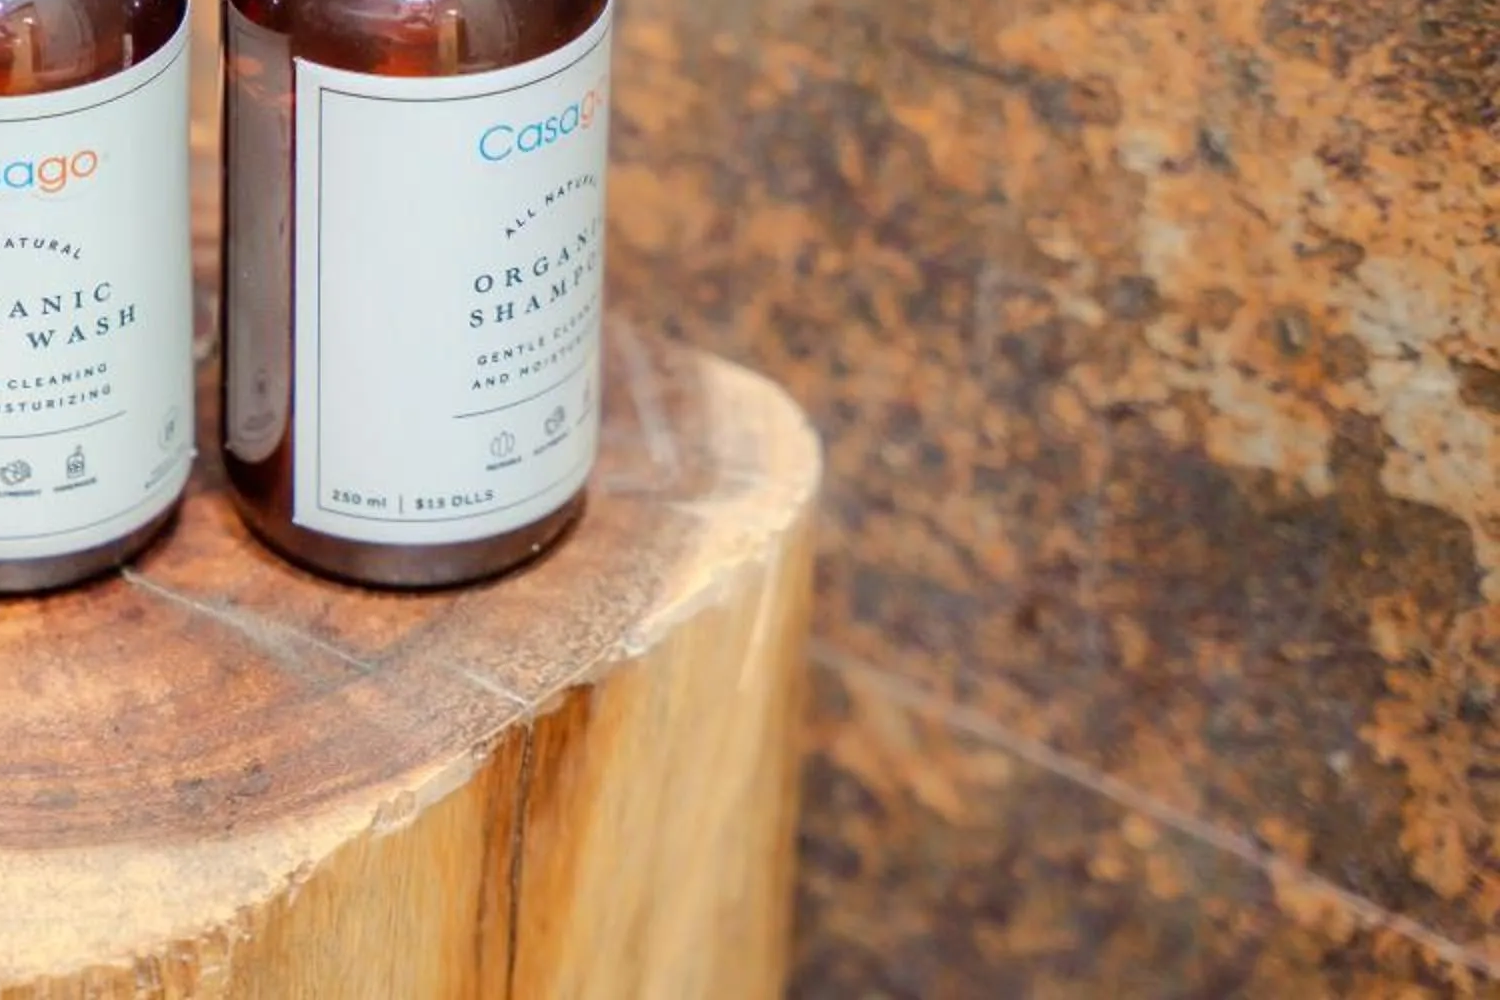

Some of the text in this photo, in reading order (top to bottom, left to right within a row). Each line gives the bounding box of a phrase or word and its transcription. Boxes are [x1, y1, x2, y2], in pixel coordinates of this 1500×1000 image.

[479, 88, 602, 162] Casag
[506, 208, 535, 240] ALL
[27, 304, 137, 350] WASH
[477, 337, 544, 366] GENTLE
[7, 363, 108, 389] CLEANING
[472, 373, 509, 390] AND
[366, 496, 387, 509] ml
